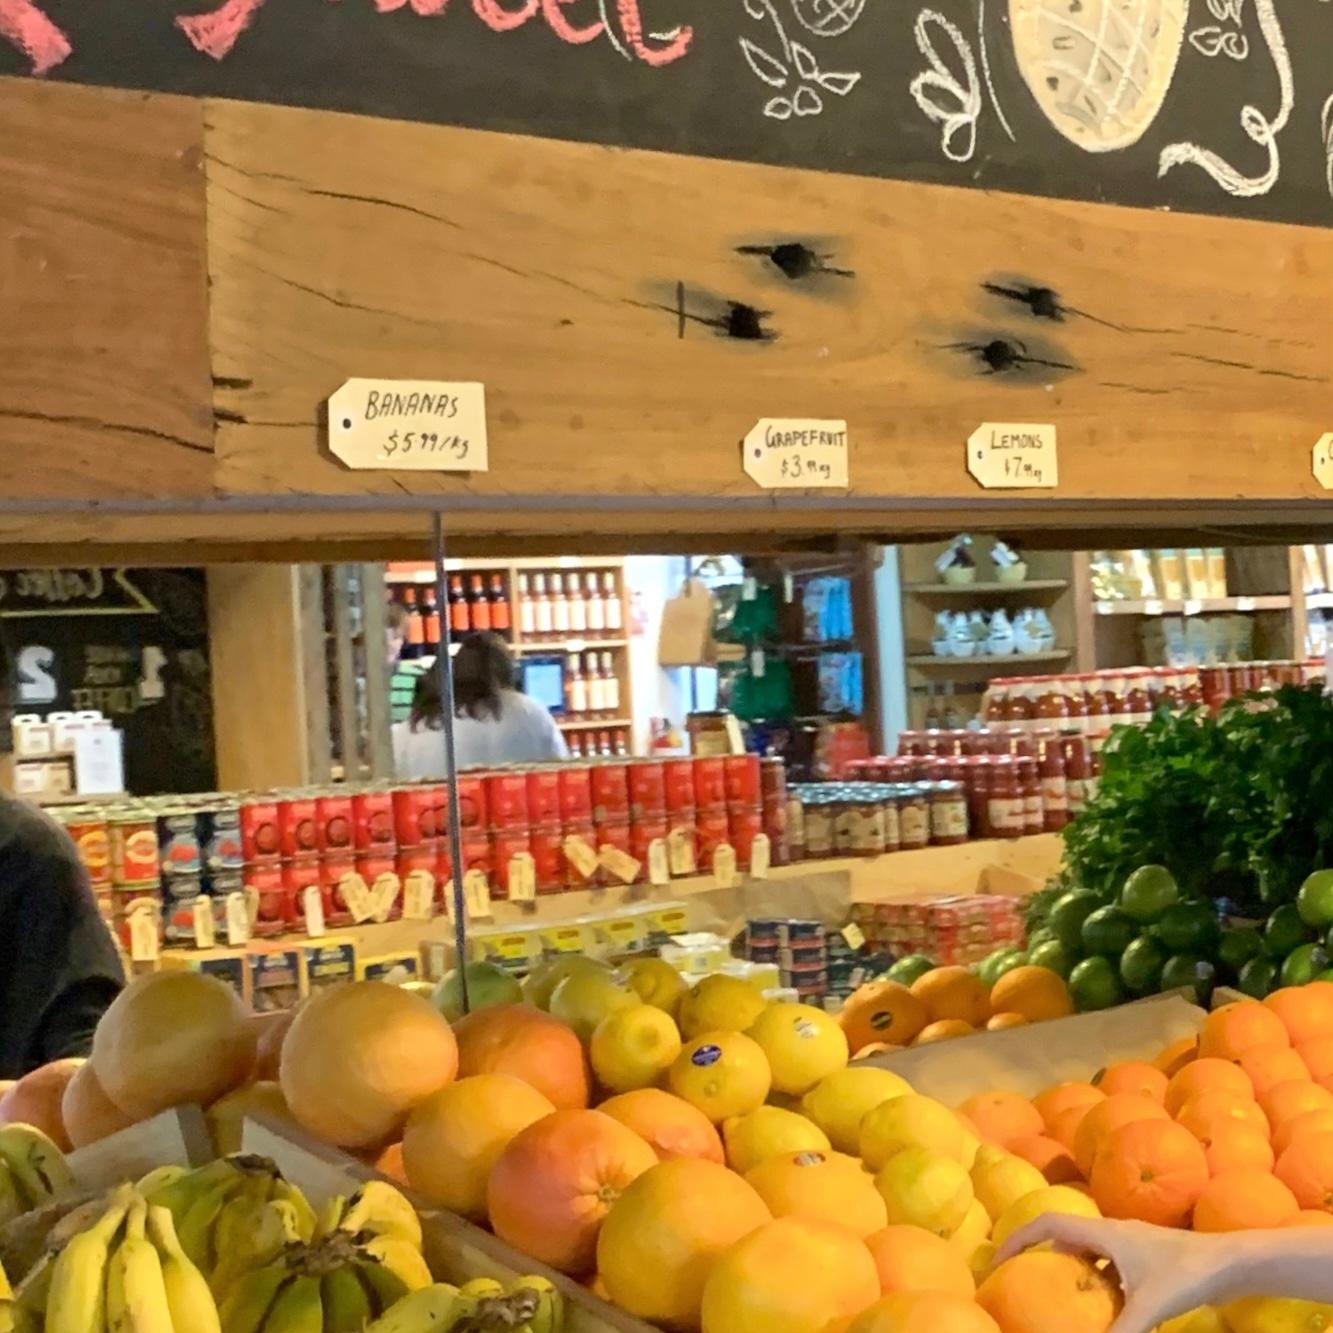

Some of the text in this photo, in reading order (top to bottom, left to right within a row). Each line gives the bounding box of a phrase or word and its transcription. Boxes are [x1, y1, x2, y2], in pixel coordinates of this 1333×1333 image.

[365, 390, 458, 420] BANANAS
[765, 425, 846, 448] GRAPEFRUIT
[990, 430, 1043, 450] LEMONS
